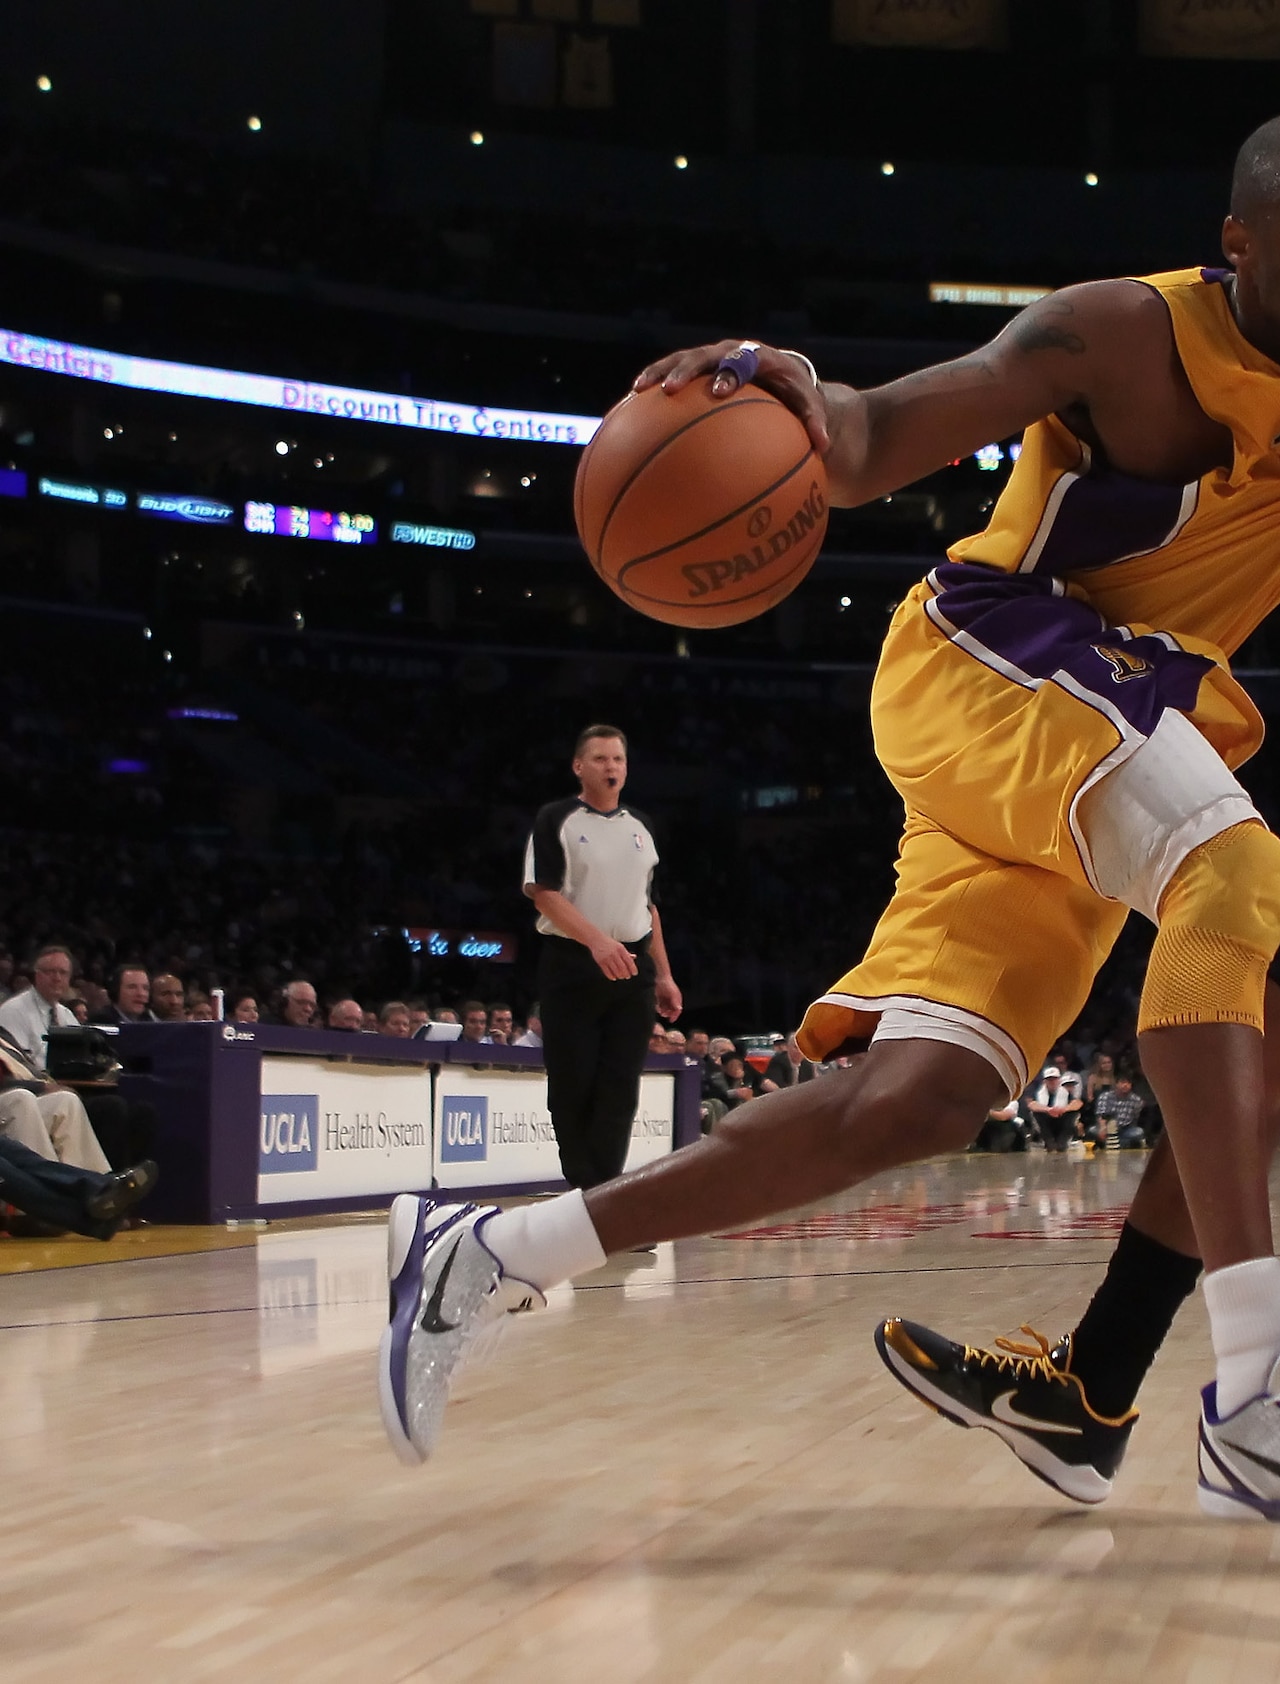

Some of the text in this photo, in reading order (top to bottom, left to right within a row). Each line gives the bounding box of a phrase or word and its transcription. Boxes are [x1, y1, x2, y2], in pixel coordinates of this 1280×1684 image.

[6, 337, 114, 383] Centers
[282, 382, 577, 442] Discount Tire Centers
[140, 497, 178, 512] BUD
[681, 480, 825, 597] SPALDING
[261, 1112, 312, 1155] UCLA
[325, 1112, 425, 1157] Health System
[447, 1110, 482, 1147] UCLA
[492, 1112, 557, 1150] Health Syste
[642, 1111, 671, 1144] System
